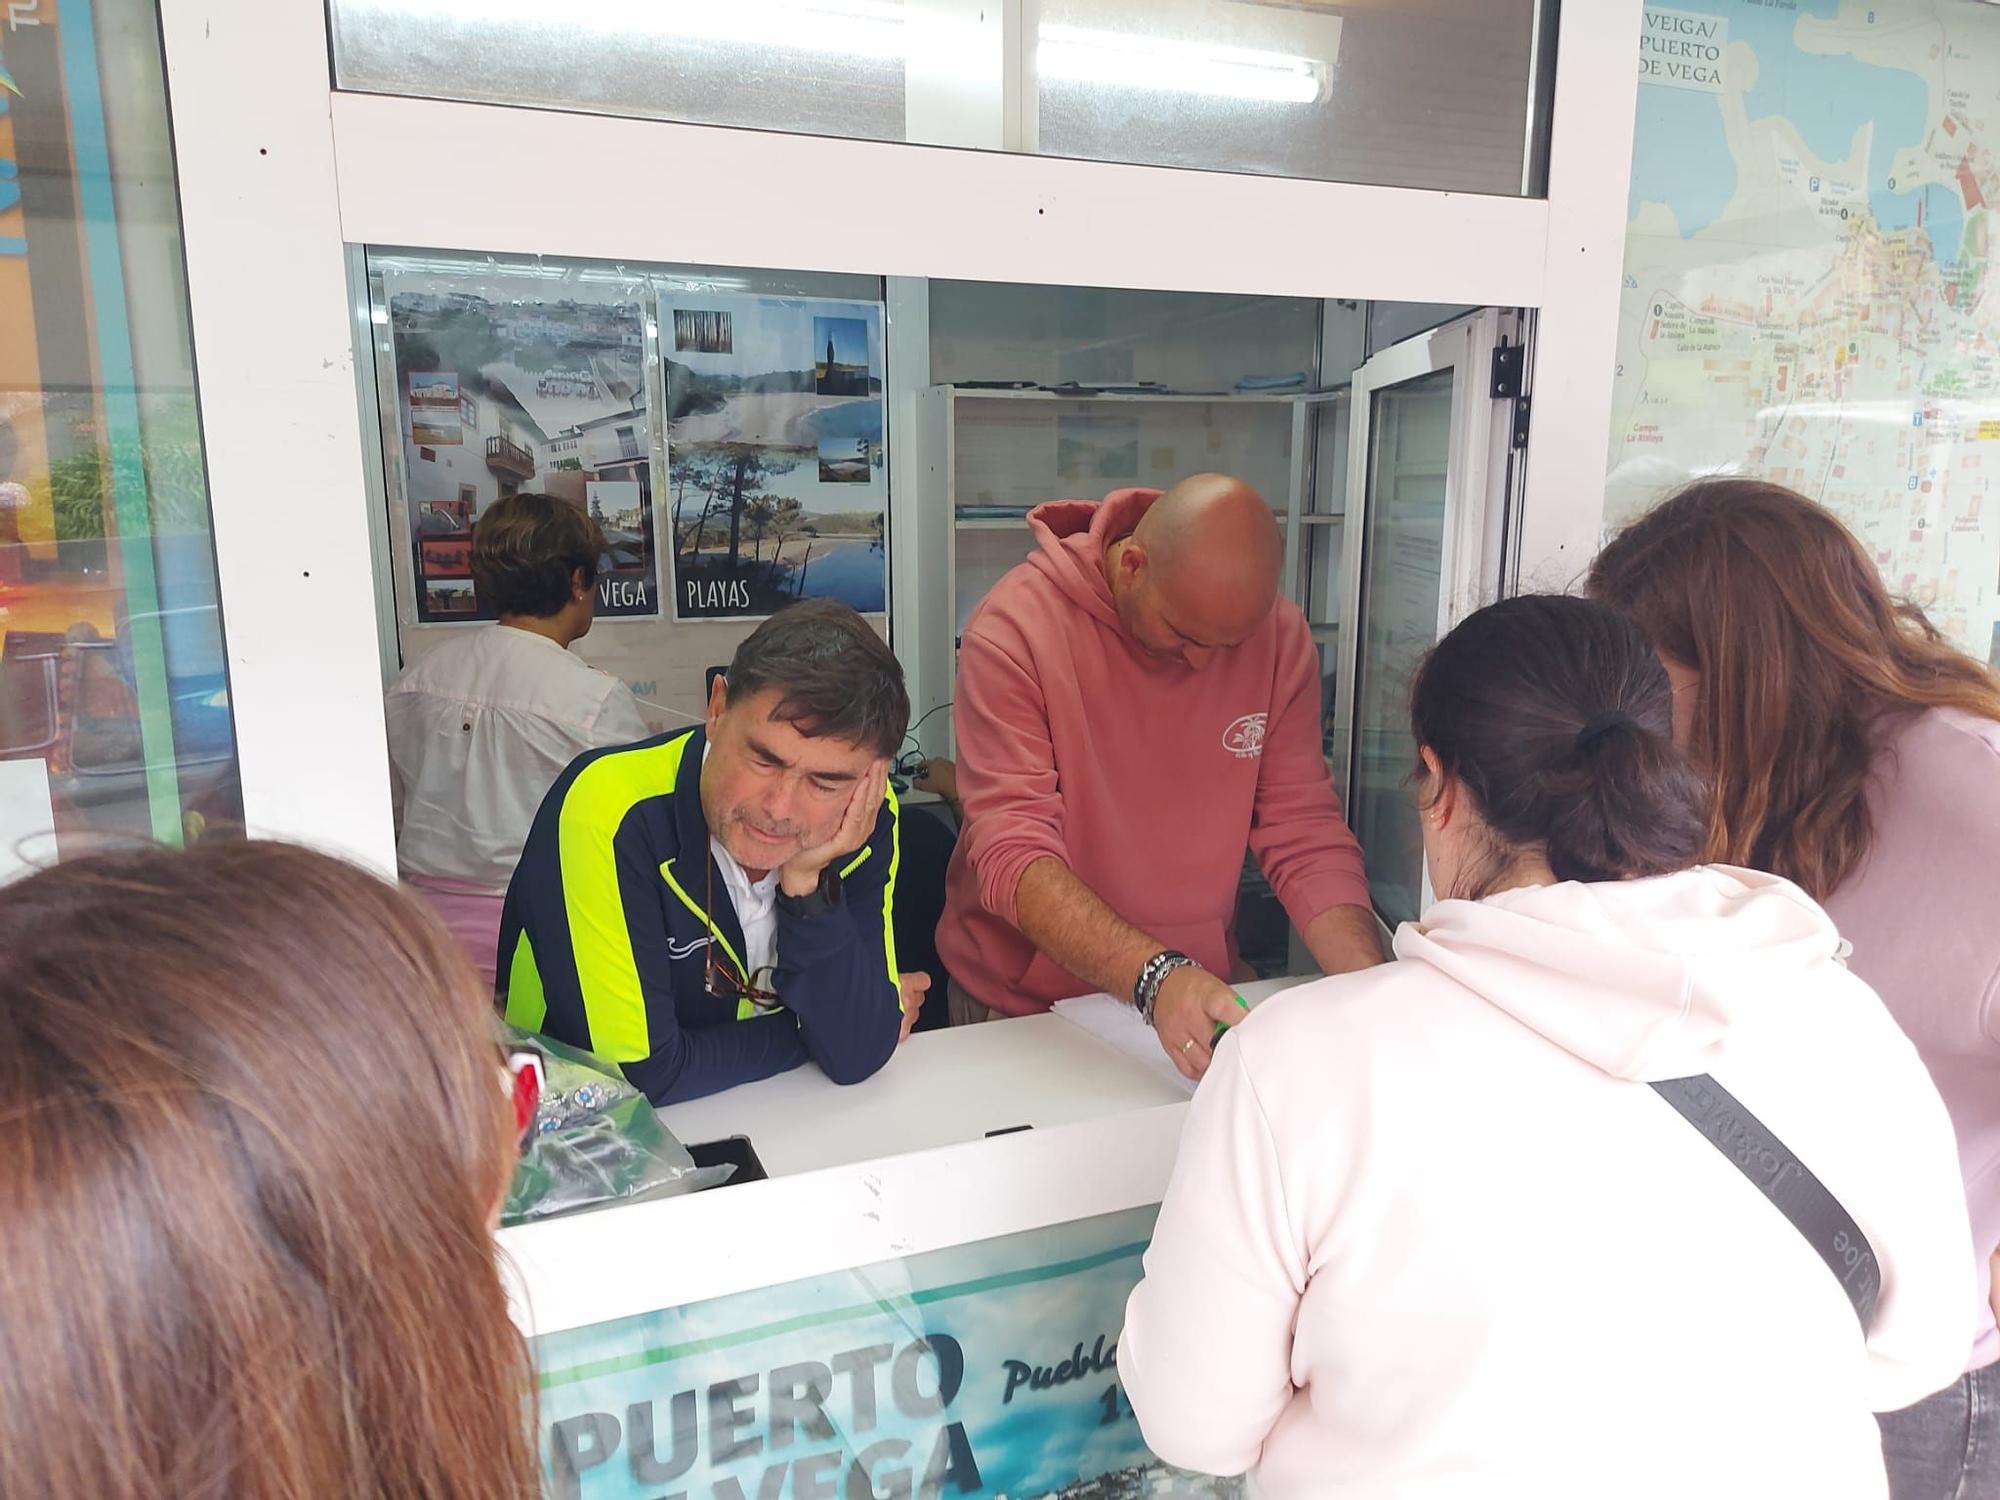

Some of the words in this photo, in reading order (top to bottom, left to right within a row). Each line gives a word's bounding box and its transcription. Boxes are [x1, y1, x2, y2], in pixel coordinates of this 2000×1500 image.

[1645, 13, 1718, 39] VEIGA/
[1640, 35, 1720, 61] PUERTO
[1639, 58, 1662, 75] DE
[1667, 62, 1722, 85] VEGA
[1616, 364, 1624, 377] 2
[600, 578, 648, 608] VEGA
[687, 579, 750, 609] PLAYAS
[552, 1333, 964, 1500] PUERTO
